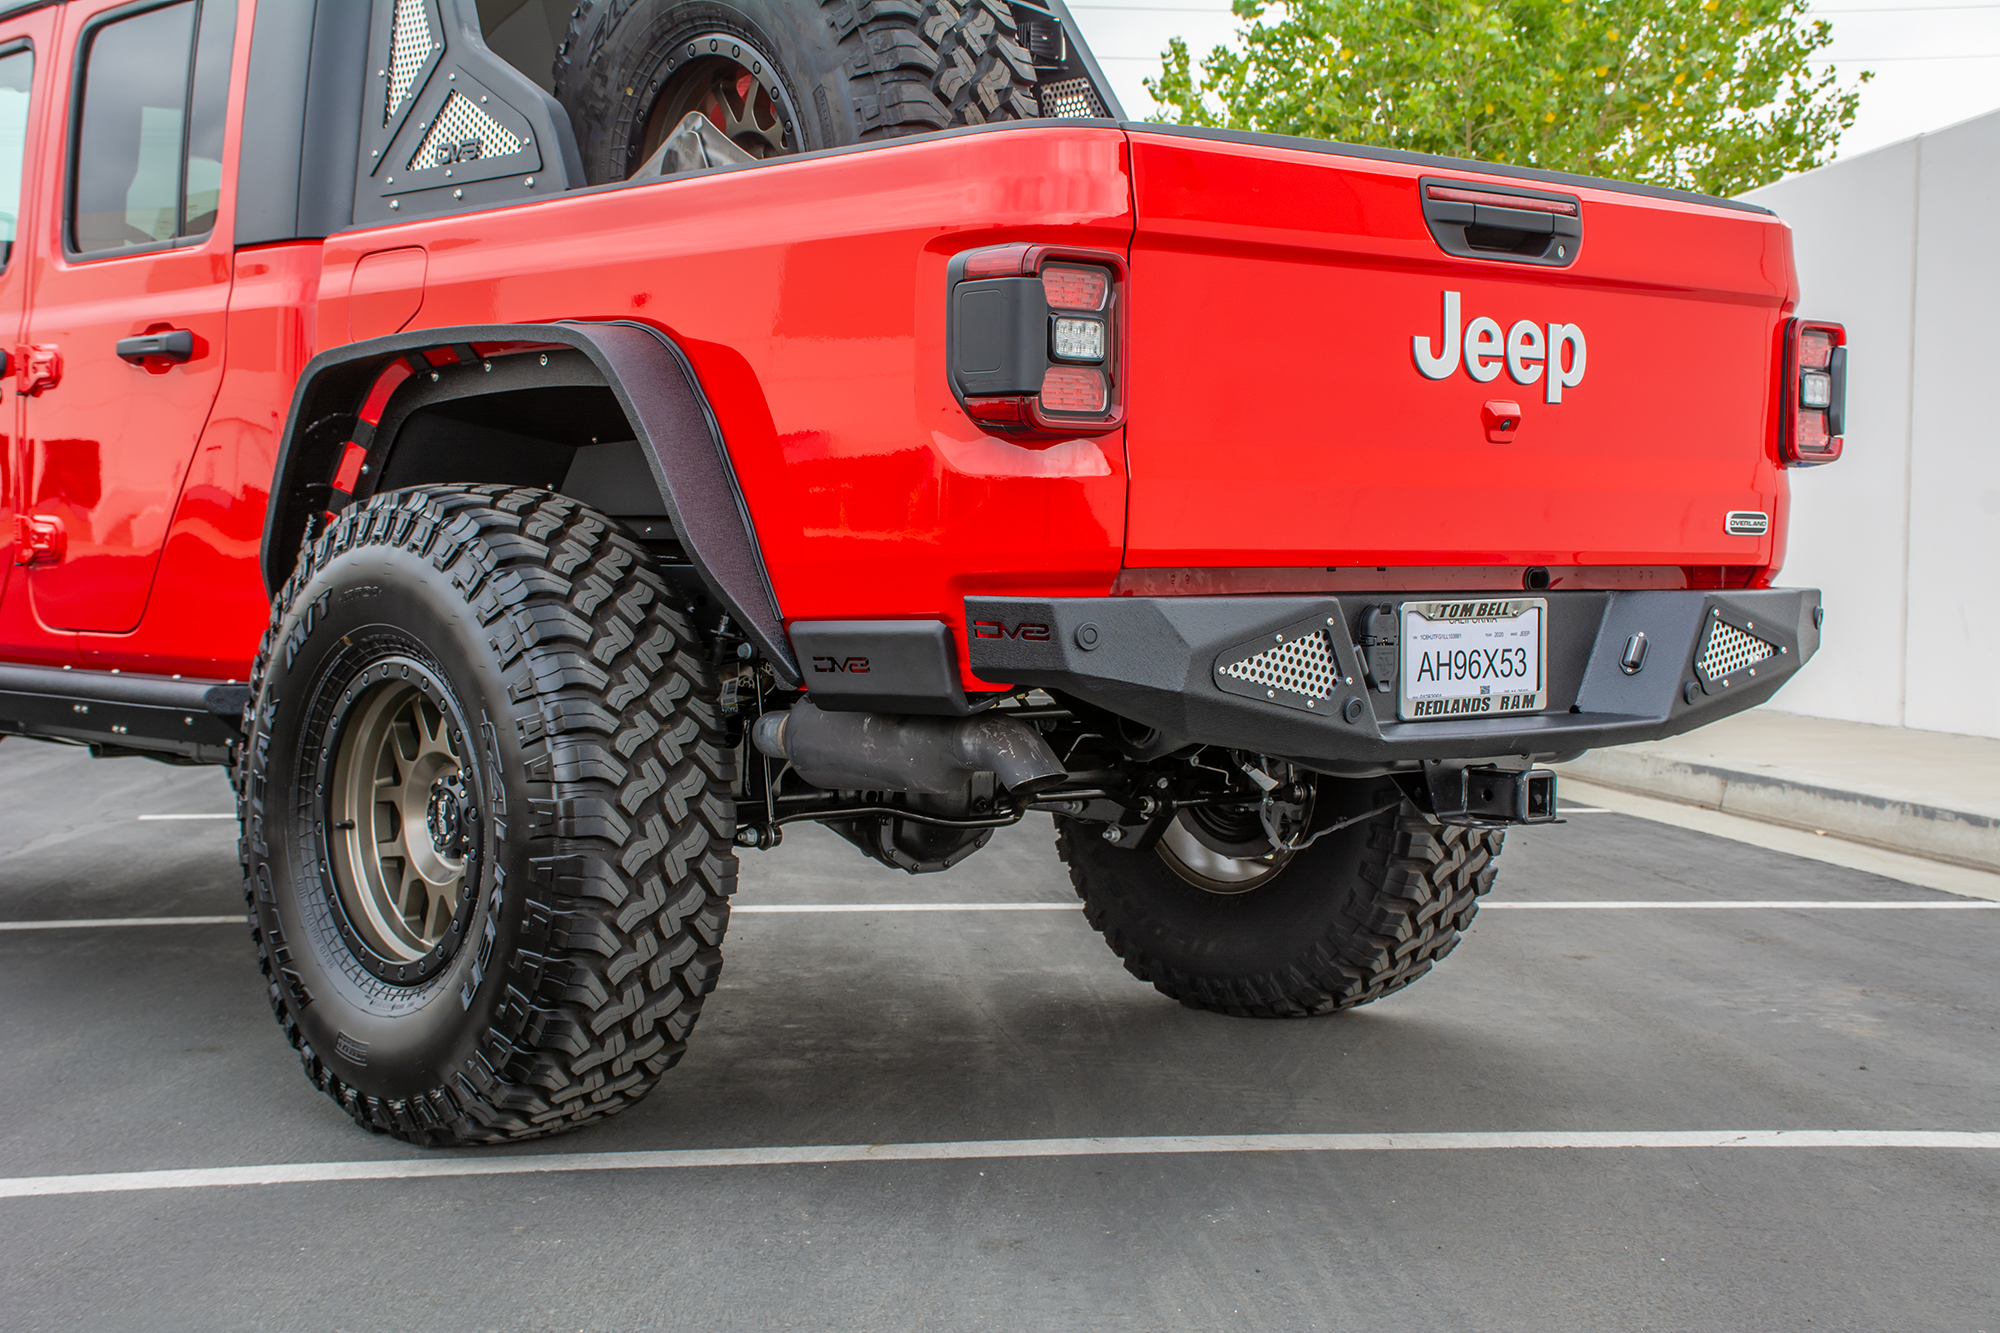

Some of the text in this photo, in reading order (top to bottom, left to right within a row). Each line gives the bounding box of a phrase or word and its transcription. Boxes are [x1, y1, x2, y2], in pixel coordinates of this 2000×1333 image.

[1410, 290, 1587, 405] Jeep
[1729, 519, 1767, 527] OVERLAND
[1439, 602, 1510, 618] TOM BELL
[1417, 647, 1528, 682] AH96X53
[1414, 694, 1536, 716] REDLANDS RAM
